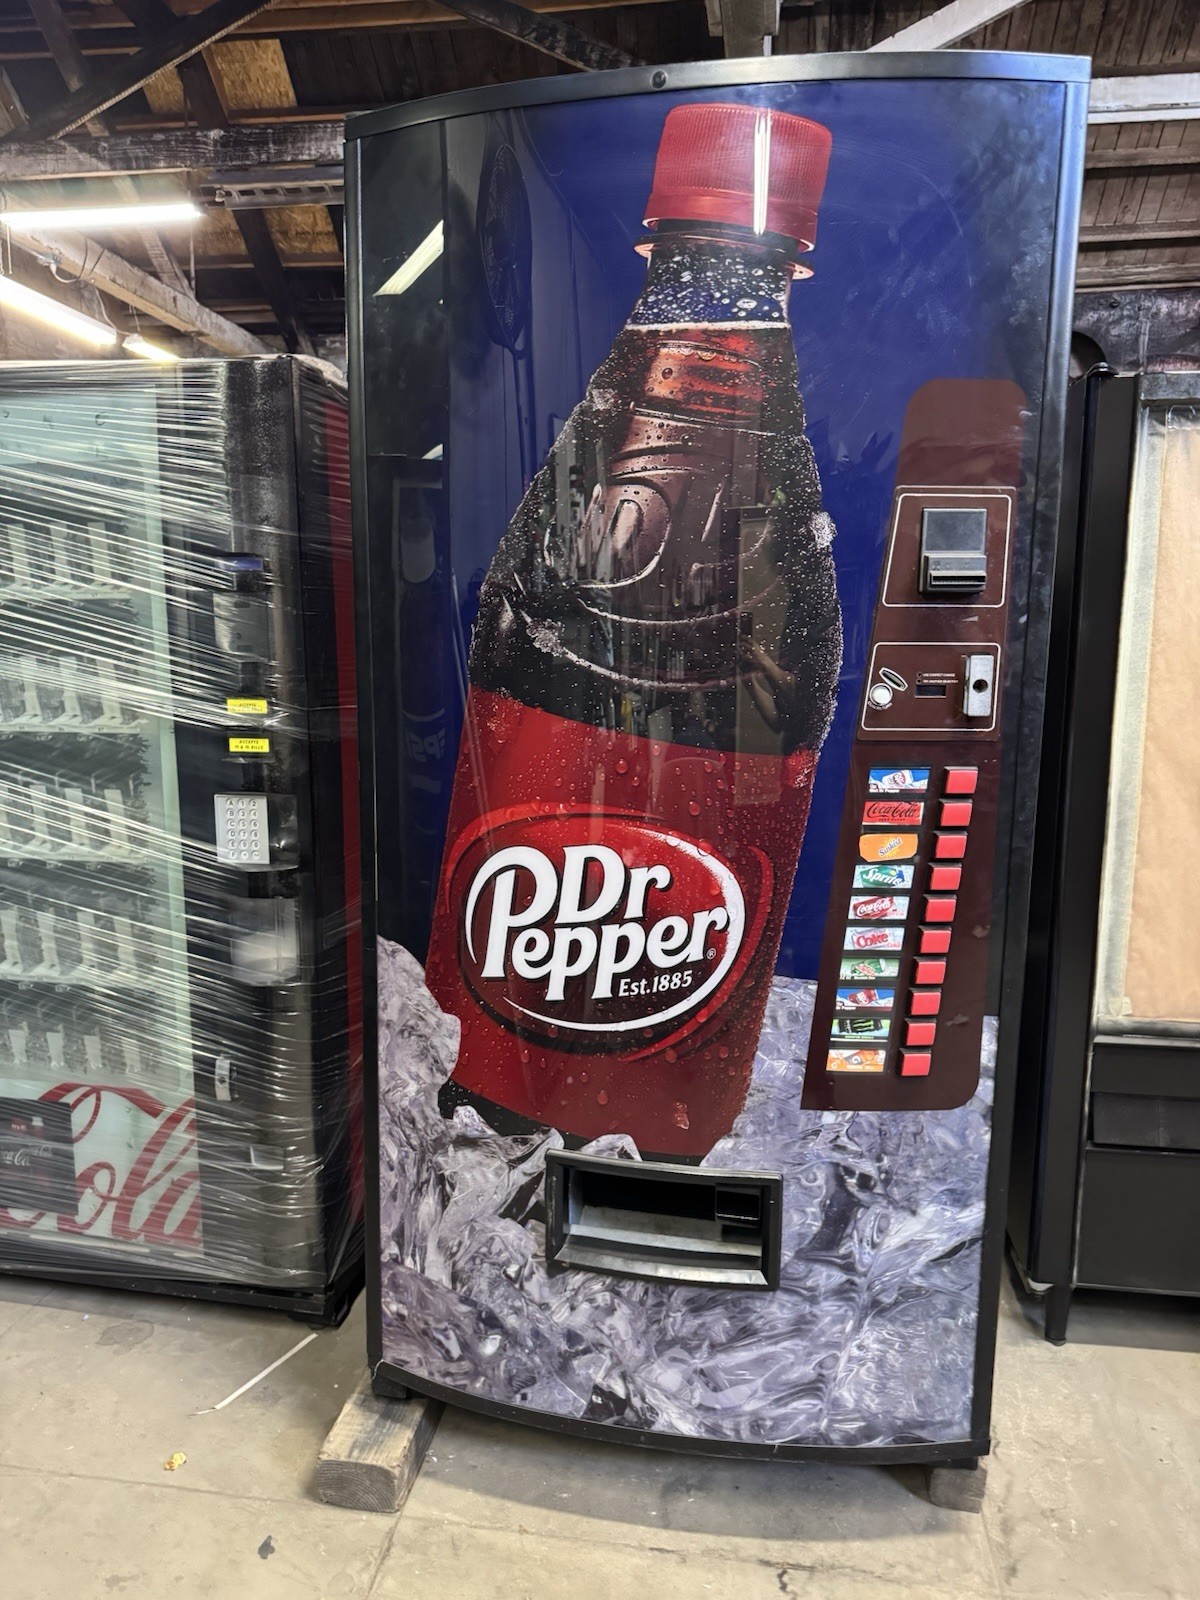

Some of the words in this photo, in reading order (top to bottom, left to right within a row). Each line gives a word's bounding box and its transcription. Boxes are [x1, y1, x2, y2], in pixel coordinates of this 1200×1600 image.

[867, 802, 918, 818] Coca-Cola
[879, 838, 902, 856] Sunkist
[554, 844, 672, 925] Dr
[863, 868, 902, 886] Sprite
[857, 897, 891, 916] Coca-Cola
[465, 845, 729, 1002] Pepper
[856, 932, 889, 948] Coke
